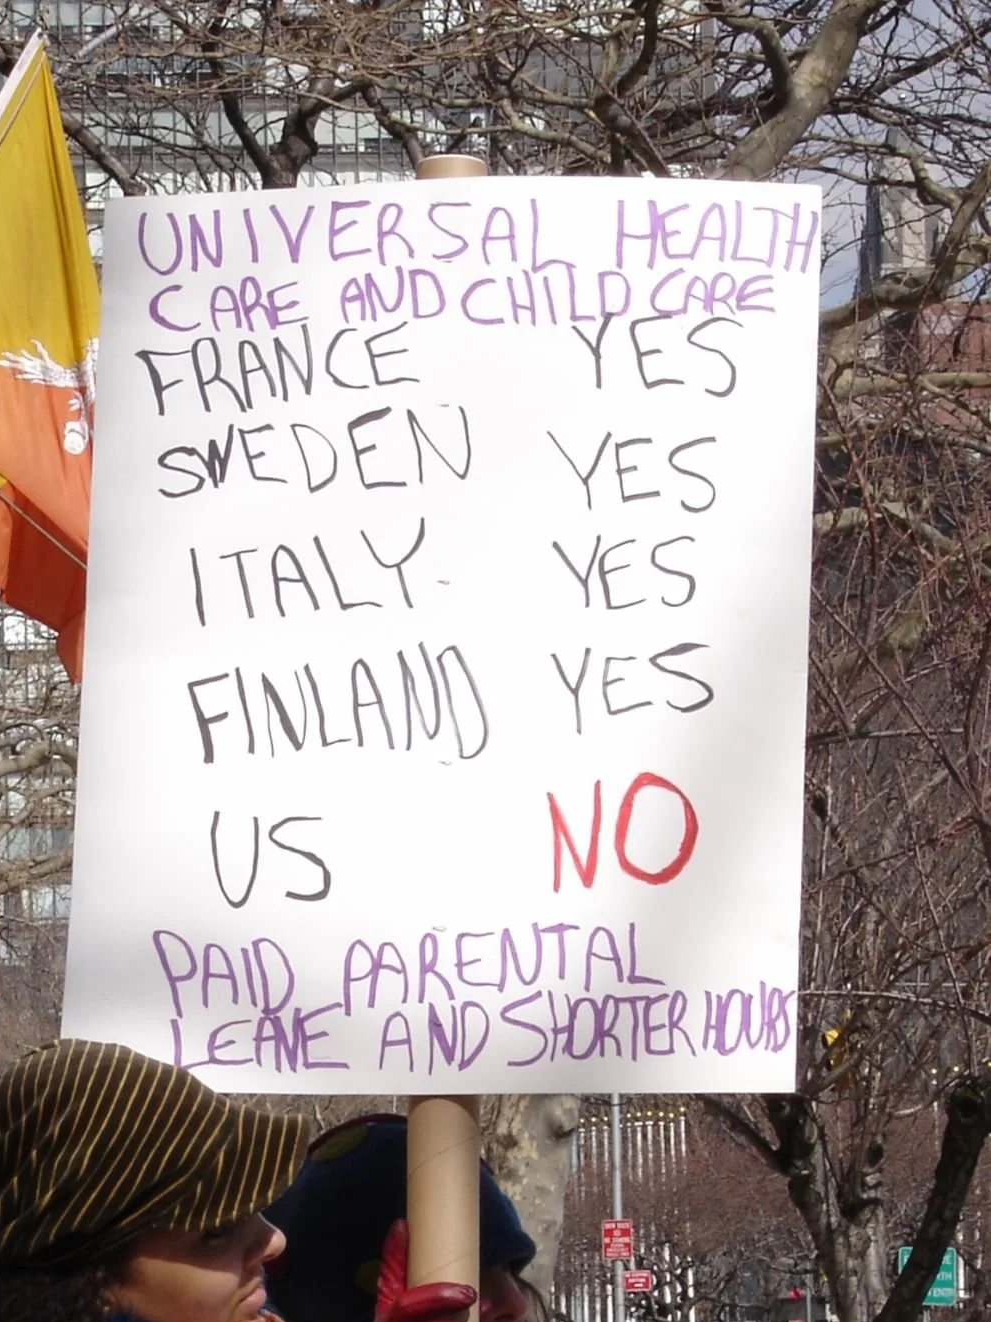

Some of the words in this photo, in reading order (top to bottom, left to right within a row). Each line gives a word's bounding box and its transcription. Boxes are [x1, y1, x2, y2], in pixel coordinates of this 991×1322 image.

[138, 198, 573, 276] UNIVERSAL
[615, 200, 818, 274] HEALTH
[149, 276, 309, 332] CARE
[340, 265, 446, 324] AND
[461, 265, 631, 327] CHILD
[650, 268, 776, 318] CARE
[134, 321, 420, 416] FRANCE
[572, 314, 743, 398] YES
[157, 406, 471, 499] SWEDEN
[546, 431, 717, 514] YES
[552, 534, 696, 611] YES
[187, 641, 489, 764] FINLAND
[550, 642, 714, 735] YES
[210, 810, 332, 909] US
[546, 772, 699, 894] NO
[152, 930, 294, 1019] PAID
[343, 922, 666, 1016] PARENTAL
[170, 1001, 350, 1073] LEAVE
[379, 1000, 490, 1076] AND
[500, 990, 696, 1068] SHORTER
[702, 980, 796, 1056] HOURS
